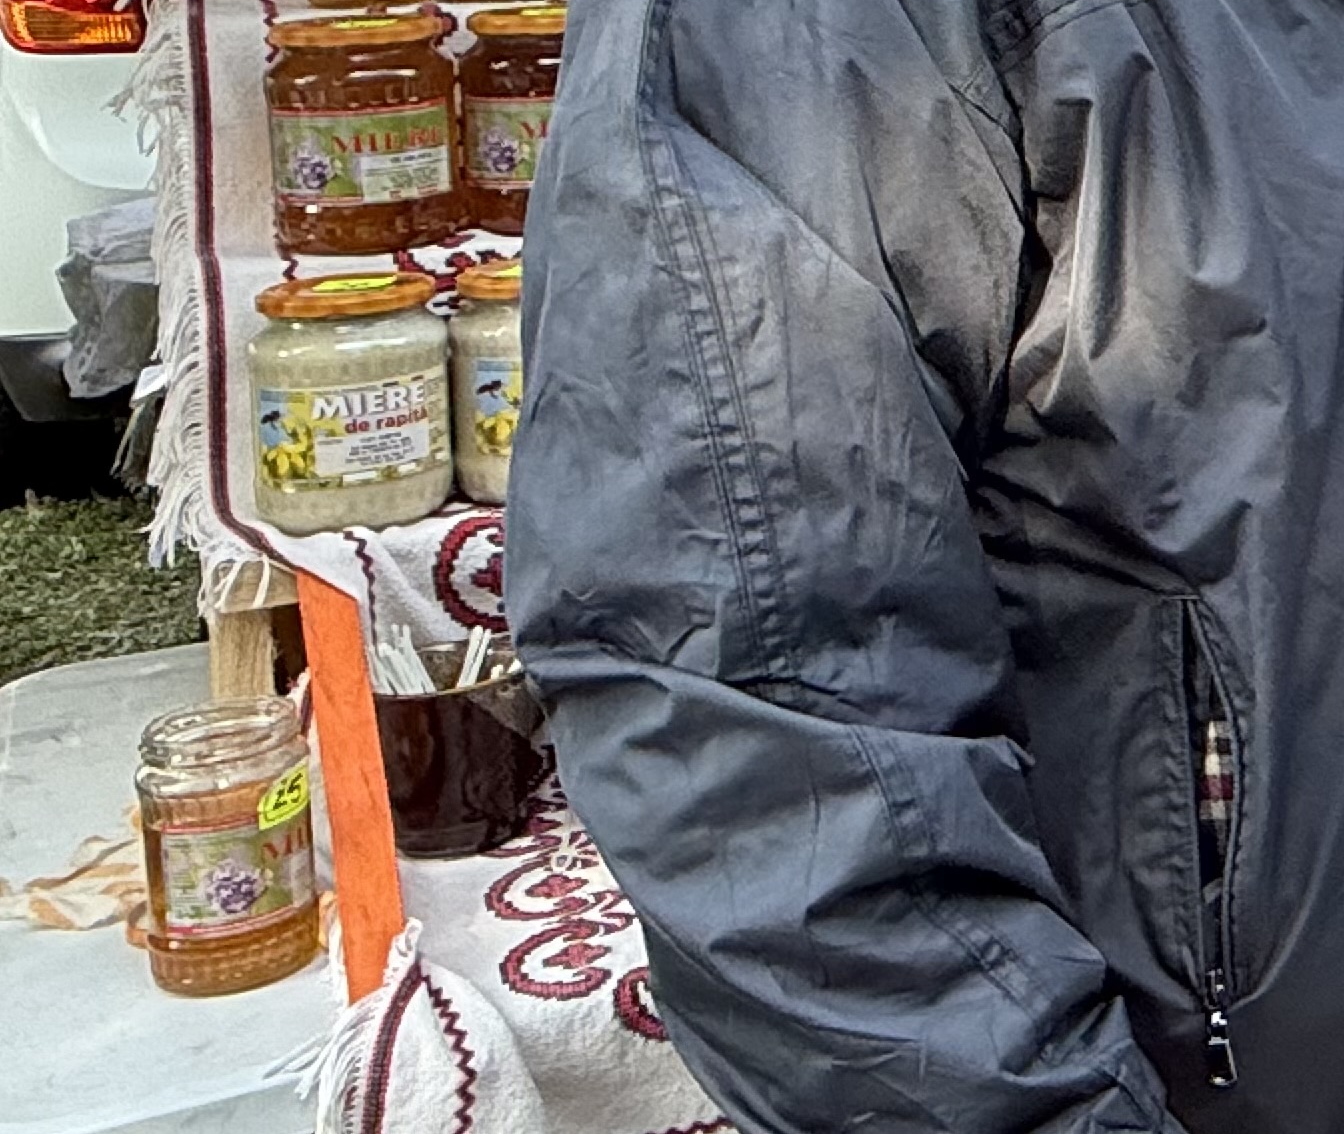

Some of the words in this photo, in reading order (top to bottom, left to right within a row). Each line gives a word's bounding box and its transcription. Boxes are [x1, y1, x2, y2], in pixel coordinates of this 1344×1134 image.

[312, 383, 427, 421] MIERE
[344, 418, 370, 434] de
[272, 773, 304, 811] 25
